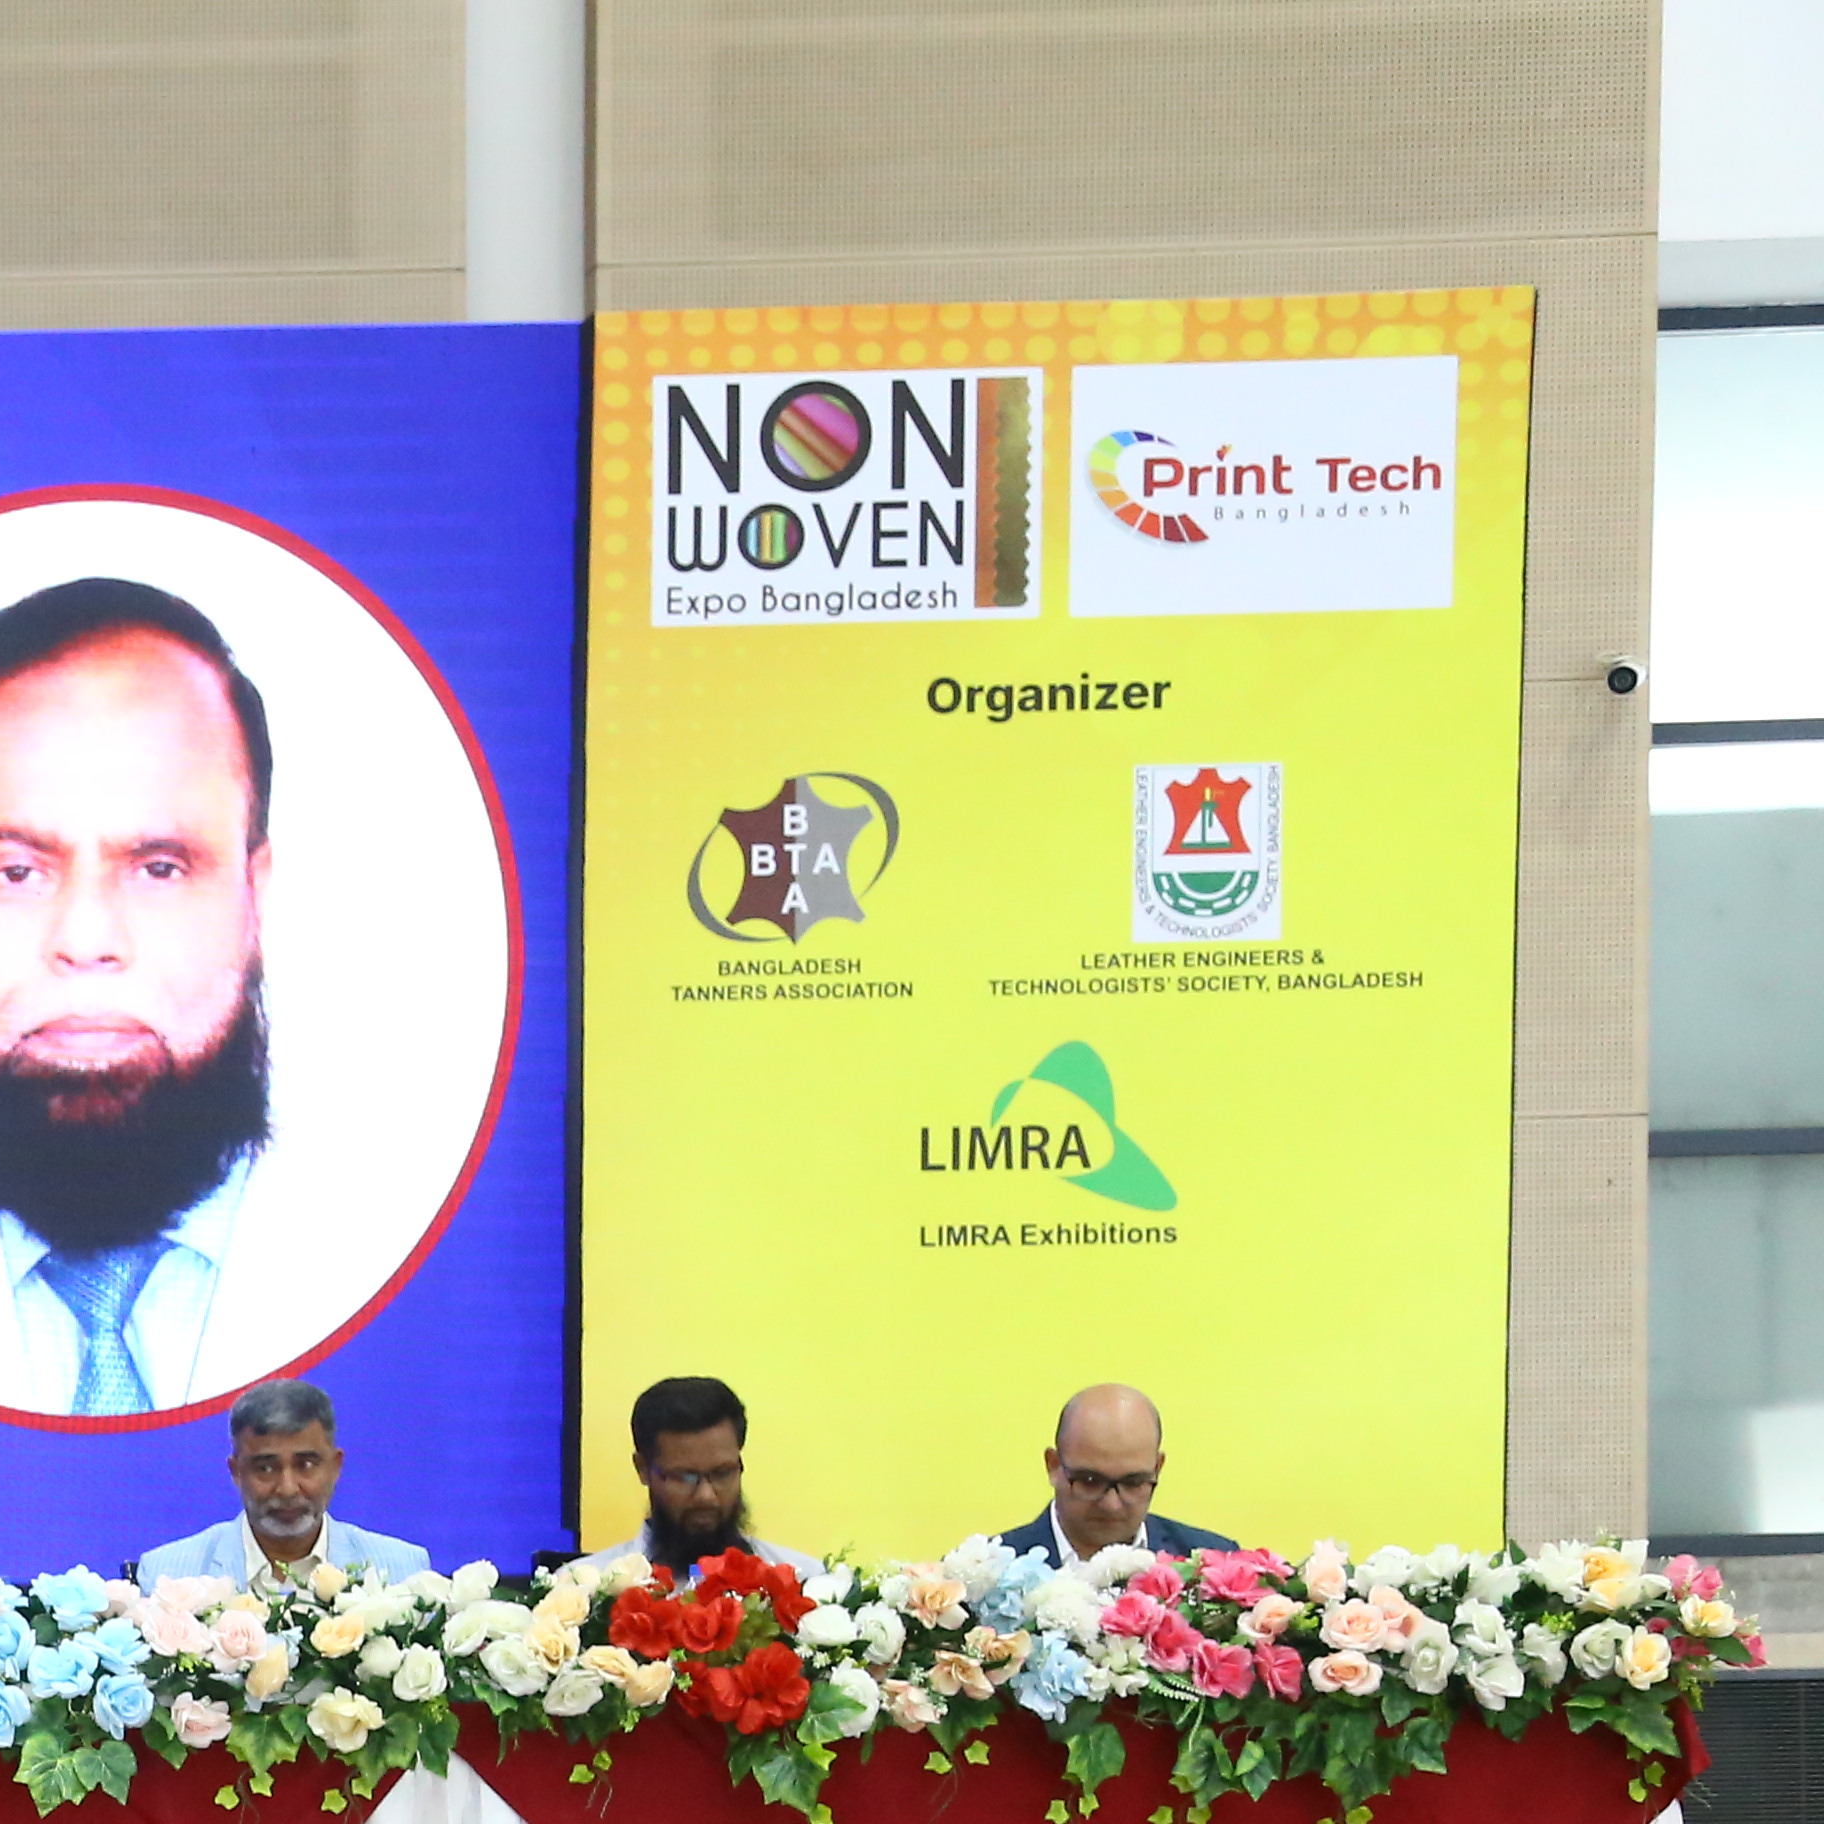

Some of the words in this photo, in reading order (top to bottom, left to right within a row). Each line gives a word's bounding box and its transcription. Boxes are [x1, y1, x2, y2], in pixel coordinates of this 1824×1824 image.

[666, 378, 968, 496] NON
[1143, 447, 1294, 498] Print
[1315, 455, 1442, 494] Tech
[1213, 500, 1410, 523] Bangladesh
[666, 499, 967, 574] WOVEN
[666, 586, 747, 620] Expo
[761, 580, 958, 617] Bangladesh
[926, 672, 1172, 724] Organizer
[750, 842, 842, 878] BTA
[718, 958, 861, 977] BANGLADESH
[1081, 952, 1176, 970] LEATHER
[1183, 949, 1304, 968] ENGINEERS
[1311, 949, 1325, 965] &
[671, 984, 768, 1002] TANNERS
[773, 981, 914, 1001] ASSOCIATION
[988, 976, 1171, 997] TECHNOLOGISTS'
[1177, 974, 1270, 993] SOCIETY,
[1277, 971, 1423, 991] BANGLADESH
[918, 1124, 1093, 1173] LIMRA
[920, 1224, 1011, 1247] LIMRA
[1020, 1221, 1178, 1246] Exhibitions
